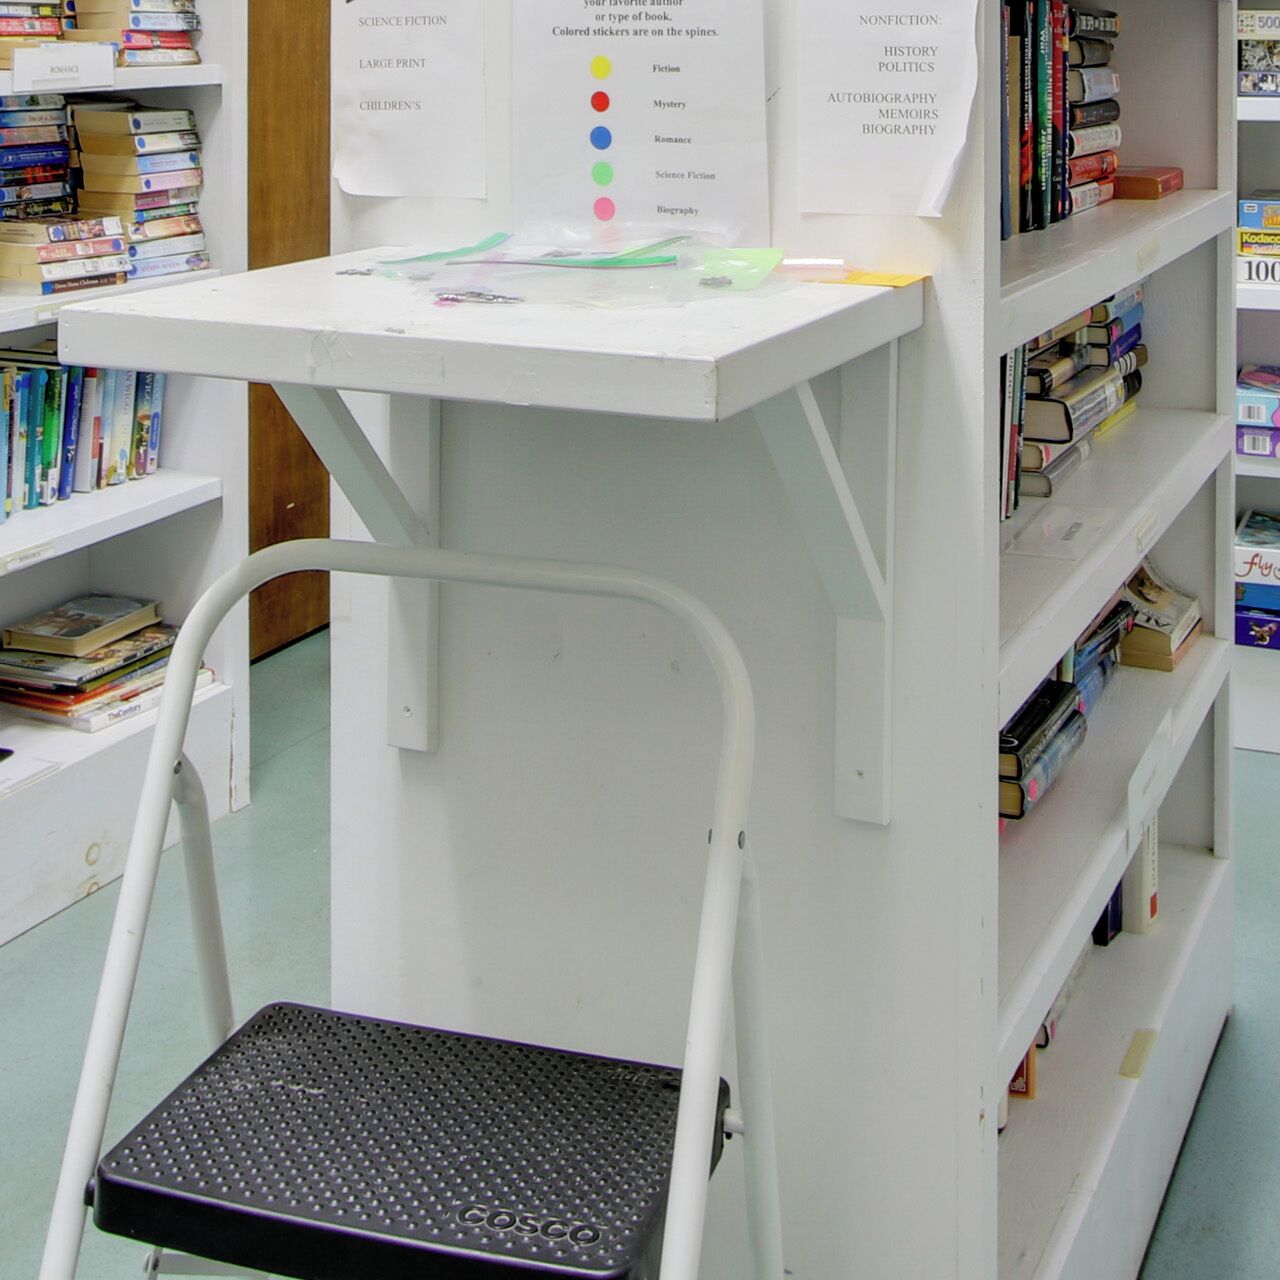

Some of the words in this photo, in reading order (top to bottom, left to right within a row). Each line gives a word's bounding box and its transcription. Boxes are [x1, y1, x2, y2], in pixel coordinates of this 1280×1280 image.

[584, 0, 606, 8] your
[359, 17, 403, 27] SCIENCE
[405, 16, 447, 25] FICTION
[609, 13, 629, 23] type
[632, 12, 643, 20] of
[645, 12, 672, 21] book.
[860, 15, 942, 25] NONFICTION:
[1258, 17, 1280, 28] 500
[552, 27, 590, 36] Colored
[593, 27, 629, 36] stickers
[633, 28, 648, 36] are
[651, 28, 663, 36] on
[667, 27, 682, 36] the
[685, 27, 718, 38] spines.
[884, 46, 938, 56] HISTORY
[360, 59, 393, 68] LARGE
[397, 58, 426, 68] PRINT
[879, 62, 934, 72] POLITICS
[50, 64, 79, 75] ROMANCE
[827, 93, 937, 103] AUTOBIOGRAPHY
[360, 101, 421, 110] CHILDREN'S
[654, 100, 686, 110] Mystery
[879, 109, 938, 119] MEMOIRS
[862, 124, 936, 135] BIOGRAPHY
[654, 135, 692, 144] Romance
[656, 171, 684, 179] Science
[688, 172, 716, 180] Fiction
[657, 206, 698, 216] Biography
[457, 1205, 602, 1247] COSCO
